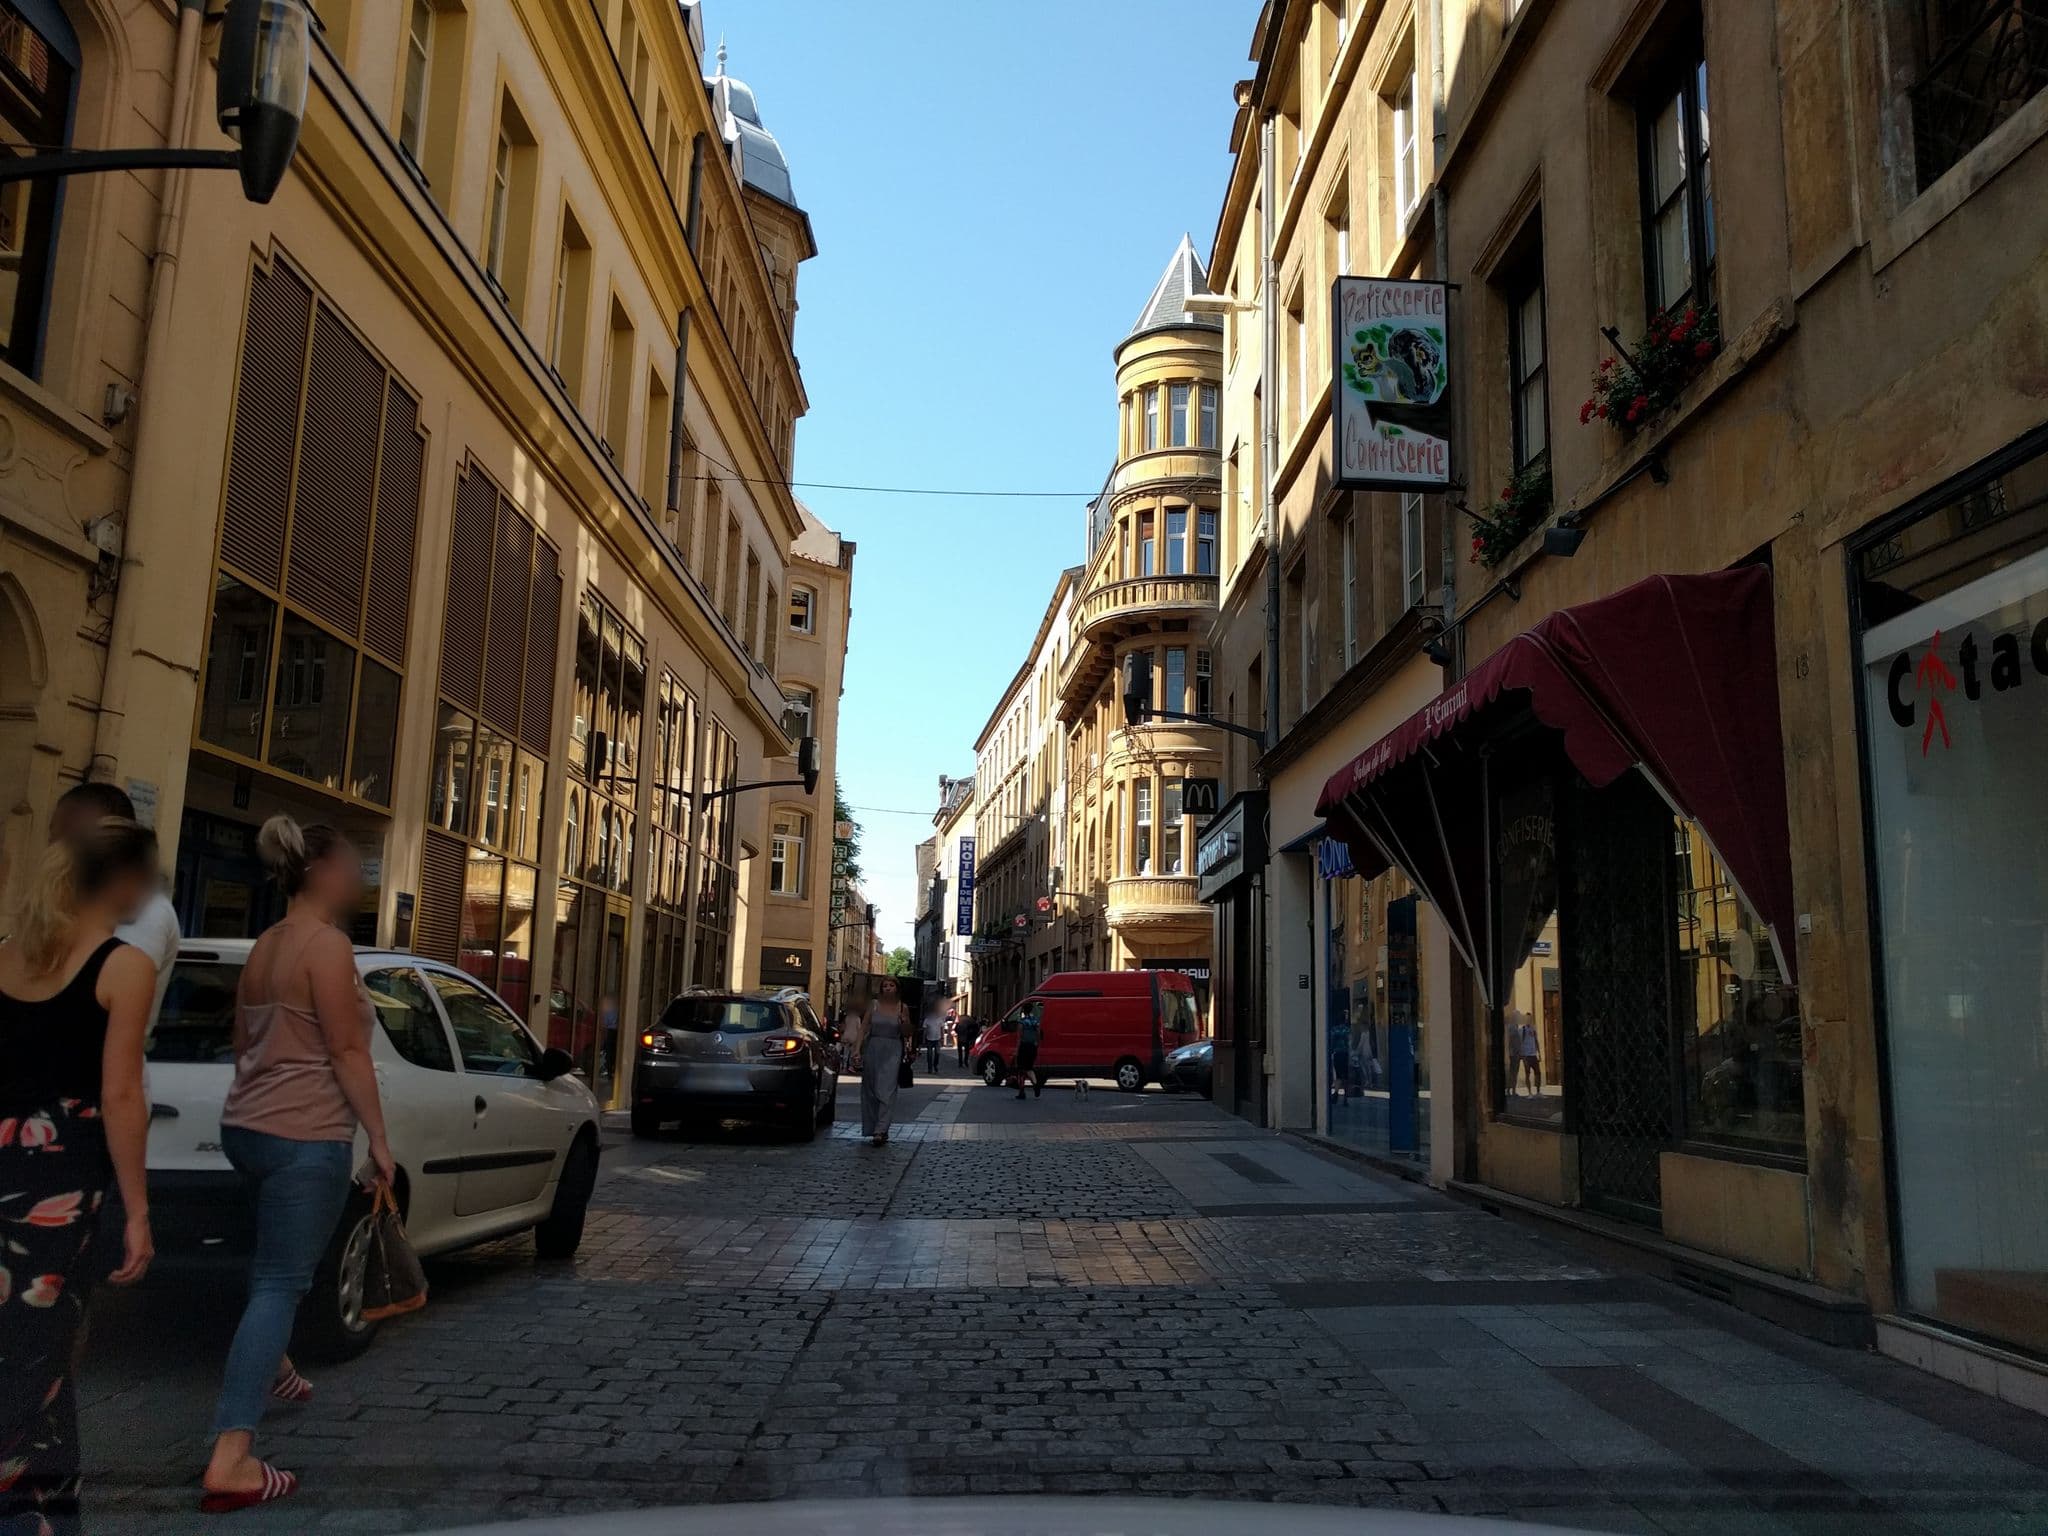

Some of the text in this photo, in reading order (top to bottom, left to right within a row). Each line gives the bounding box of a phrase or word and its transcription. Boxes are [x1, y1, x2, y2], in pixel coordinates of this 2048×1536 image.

[1345, 414, 1445, 475] Confiserie
[832, 846, 846, 924] ROLEX
[961, 842, 973, 888] HOTEL
[959, 896, 972, 934] METZ
